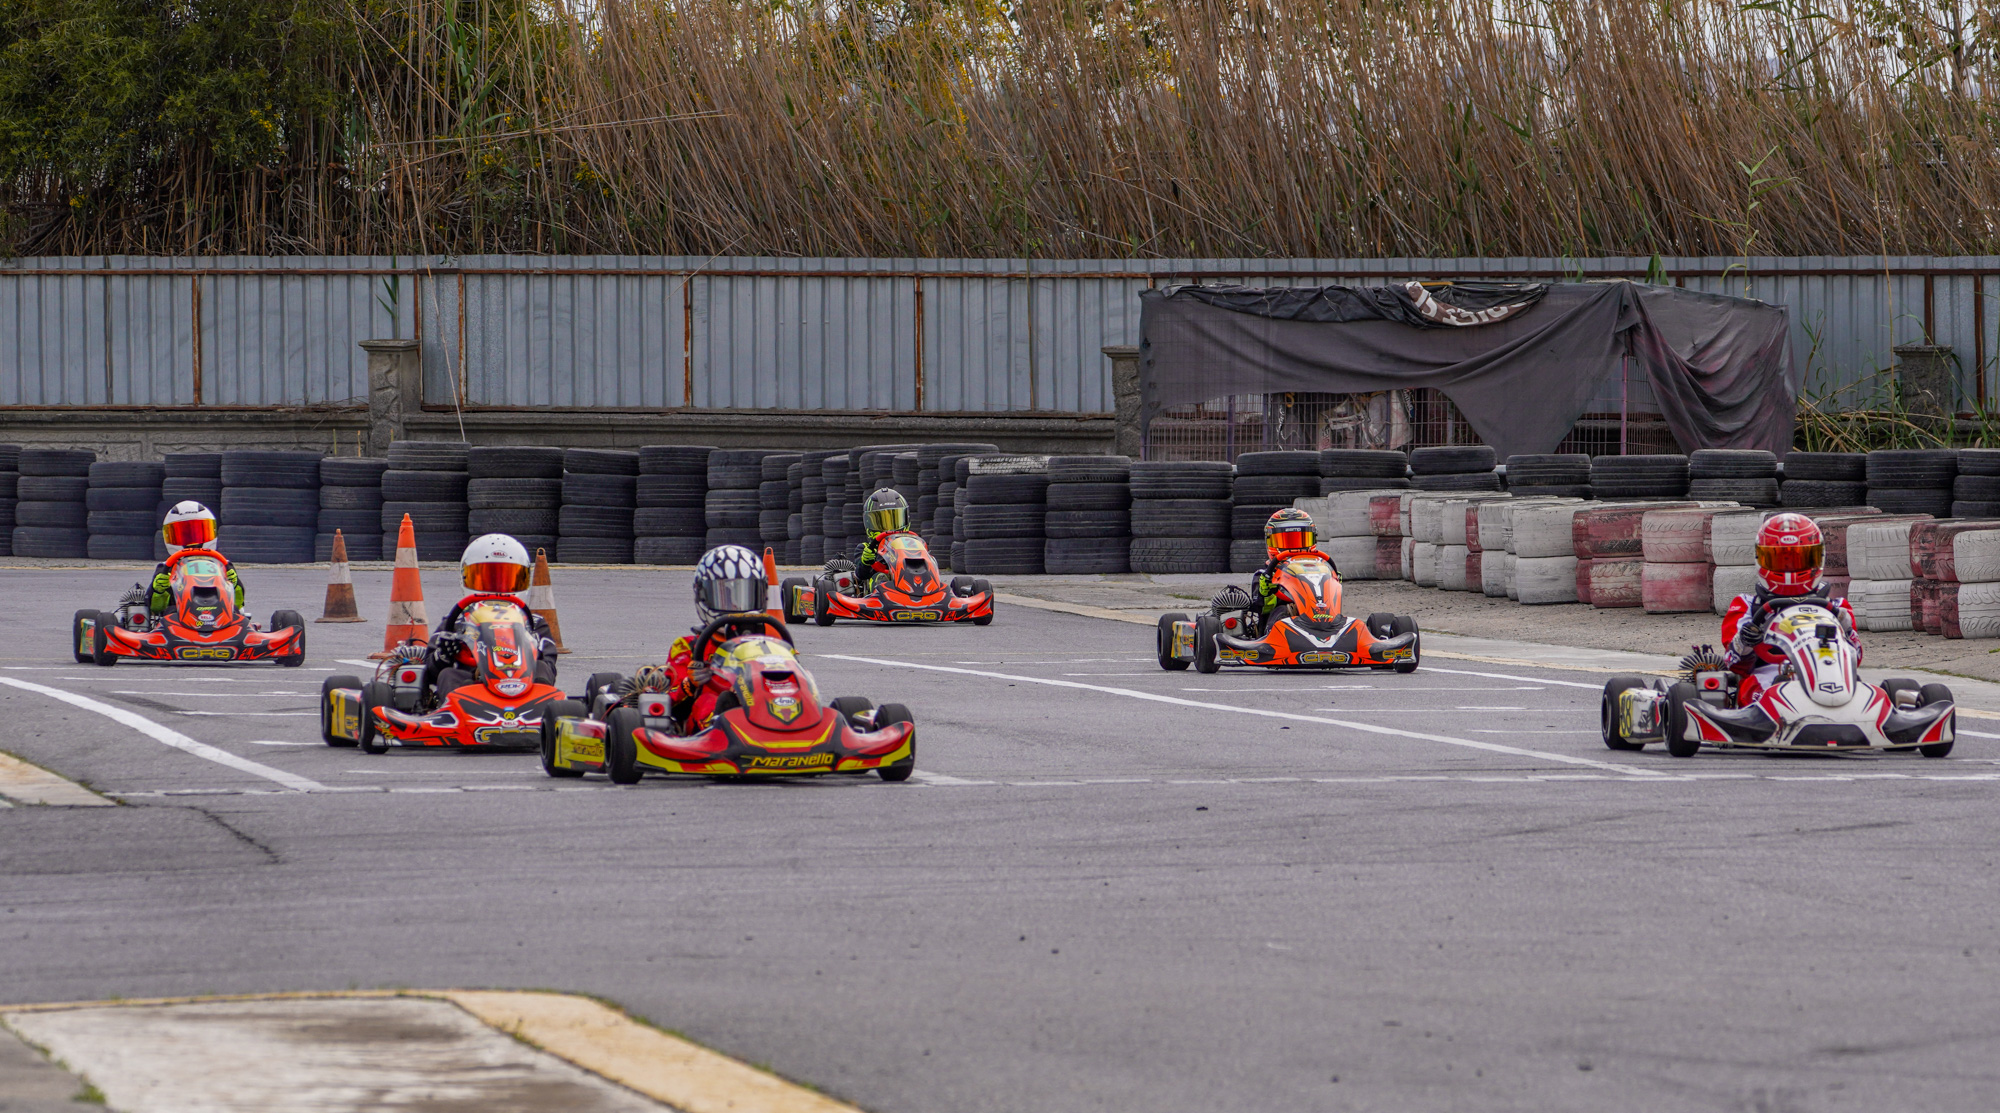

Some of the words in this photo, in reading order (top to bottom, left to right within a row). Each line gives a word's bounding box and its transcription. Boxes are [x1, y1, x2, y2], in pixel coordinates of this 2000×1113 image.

[896, 611, 937, 621] CRG
[182, 649, 230, 659] CRG
[1220, 649, 1259, 659] CRG
[1303, 654, 1347, 662] CRG
[1382, 649, 1412, 659] CRG
[750, 753, 834, 767] Maranello
